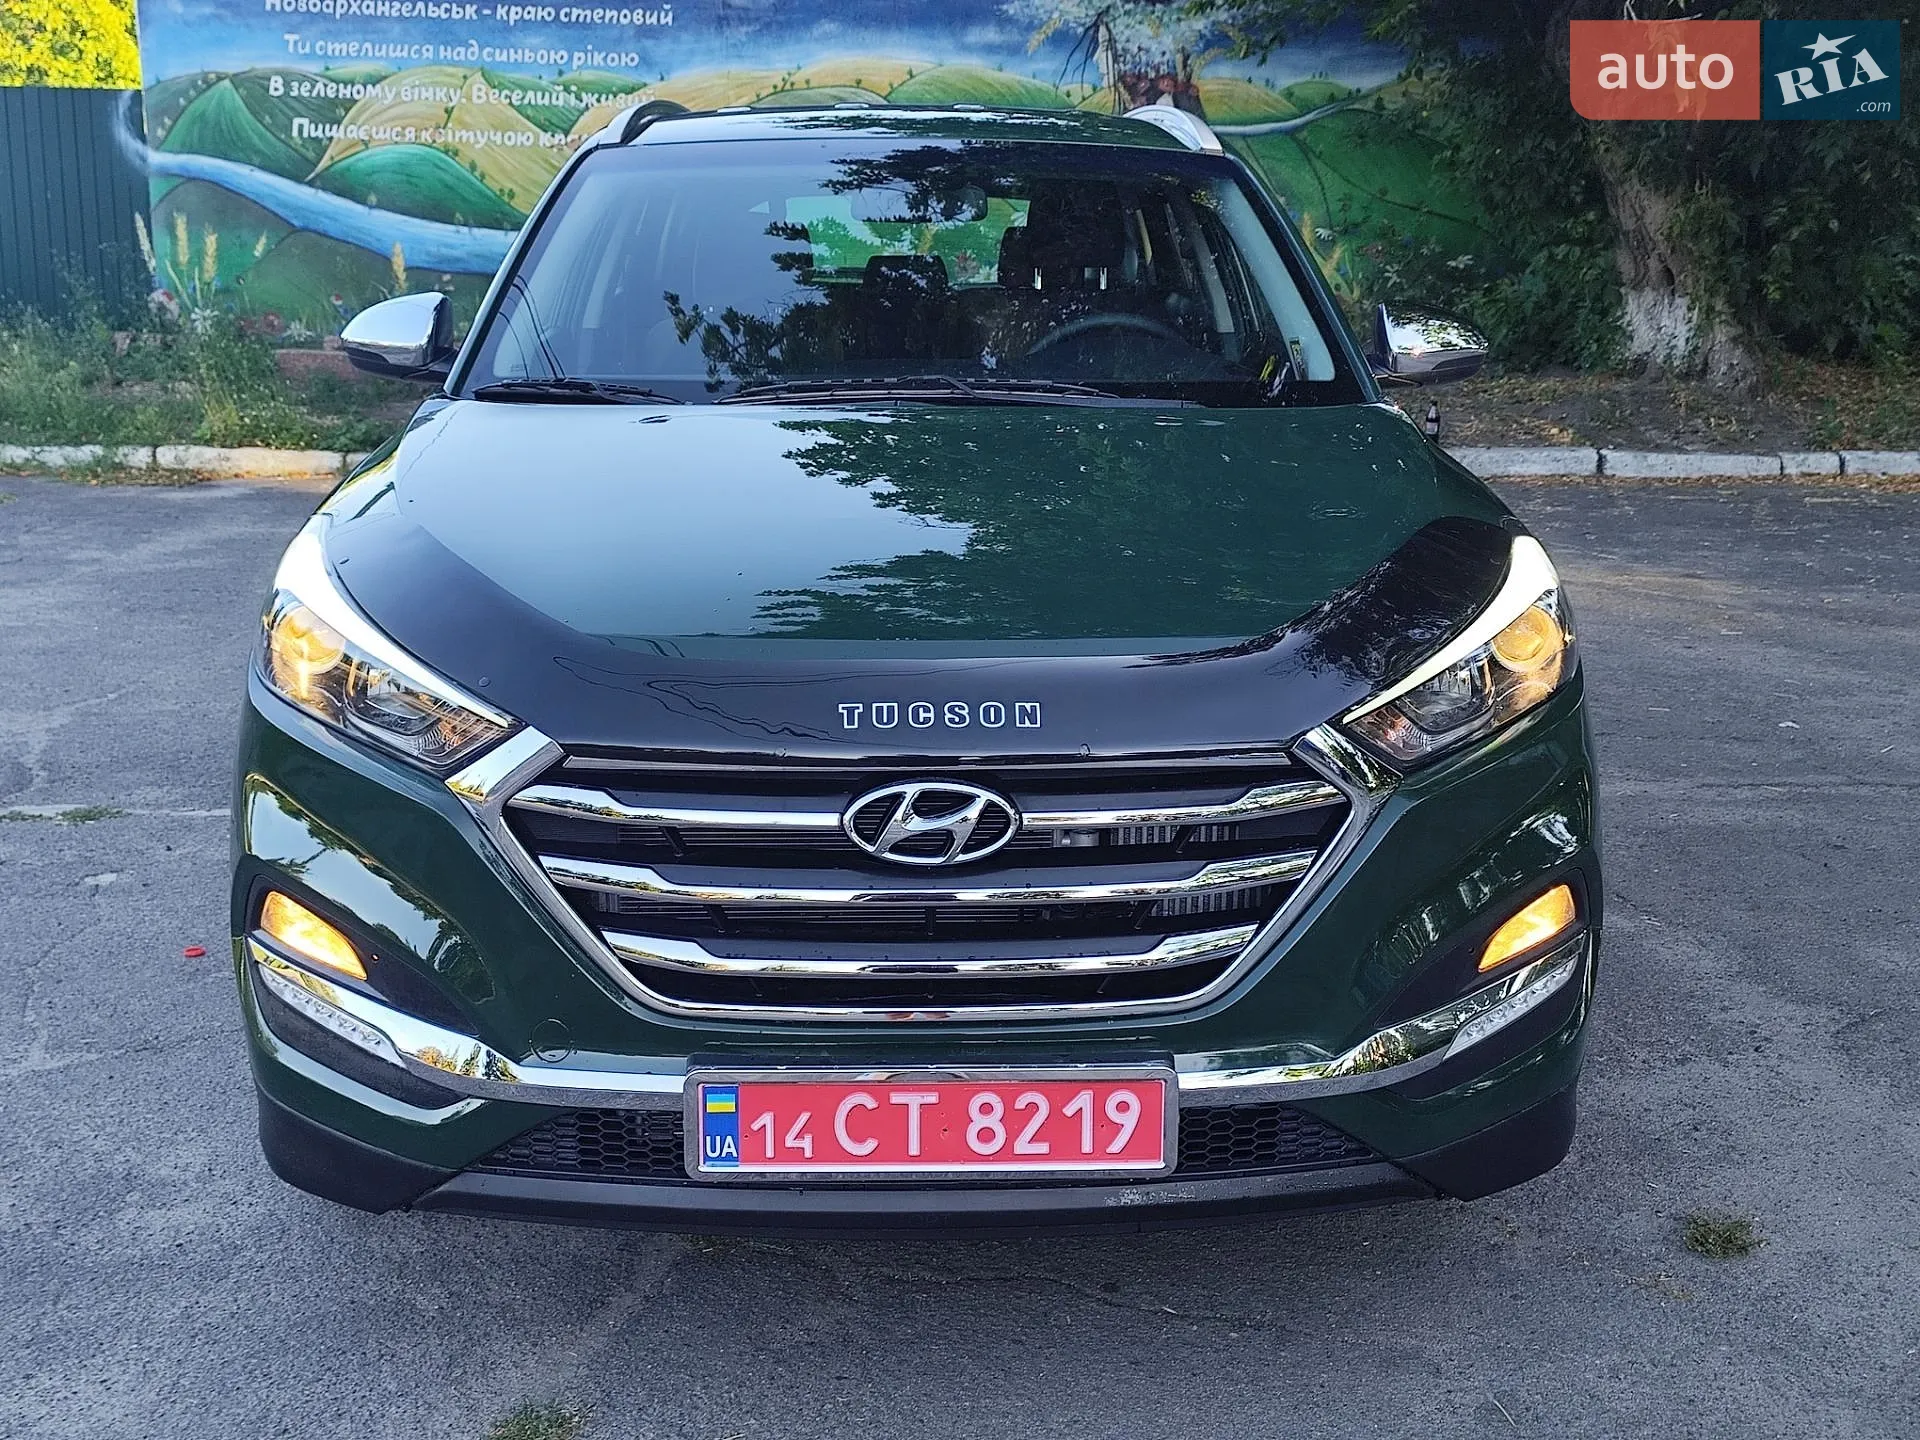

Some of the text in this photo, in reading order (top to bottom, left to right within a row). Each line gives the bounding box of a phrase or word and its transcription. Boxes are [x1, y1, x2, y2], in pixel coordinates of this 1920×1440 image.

[496, 4, 555, 26] краю
[559, 4, 674, 27] степовий
[284, 33, 641, 70] Ти стелишся над синьою рікою
[268, 75, 285, 98] В
[289, 79, 396, 105] зеленому
[471, 84, 566, 108] Веселий
[292, 116, 416, 142] Пишаєшся
[838, 701, 1042, 729] TUCSON
[749, 1088, 1143, 1160] 14 CT 8219
[705, 1135, 738, 1158] UA
